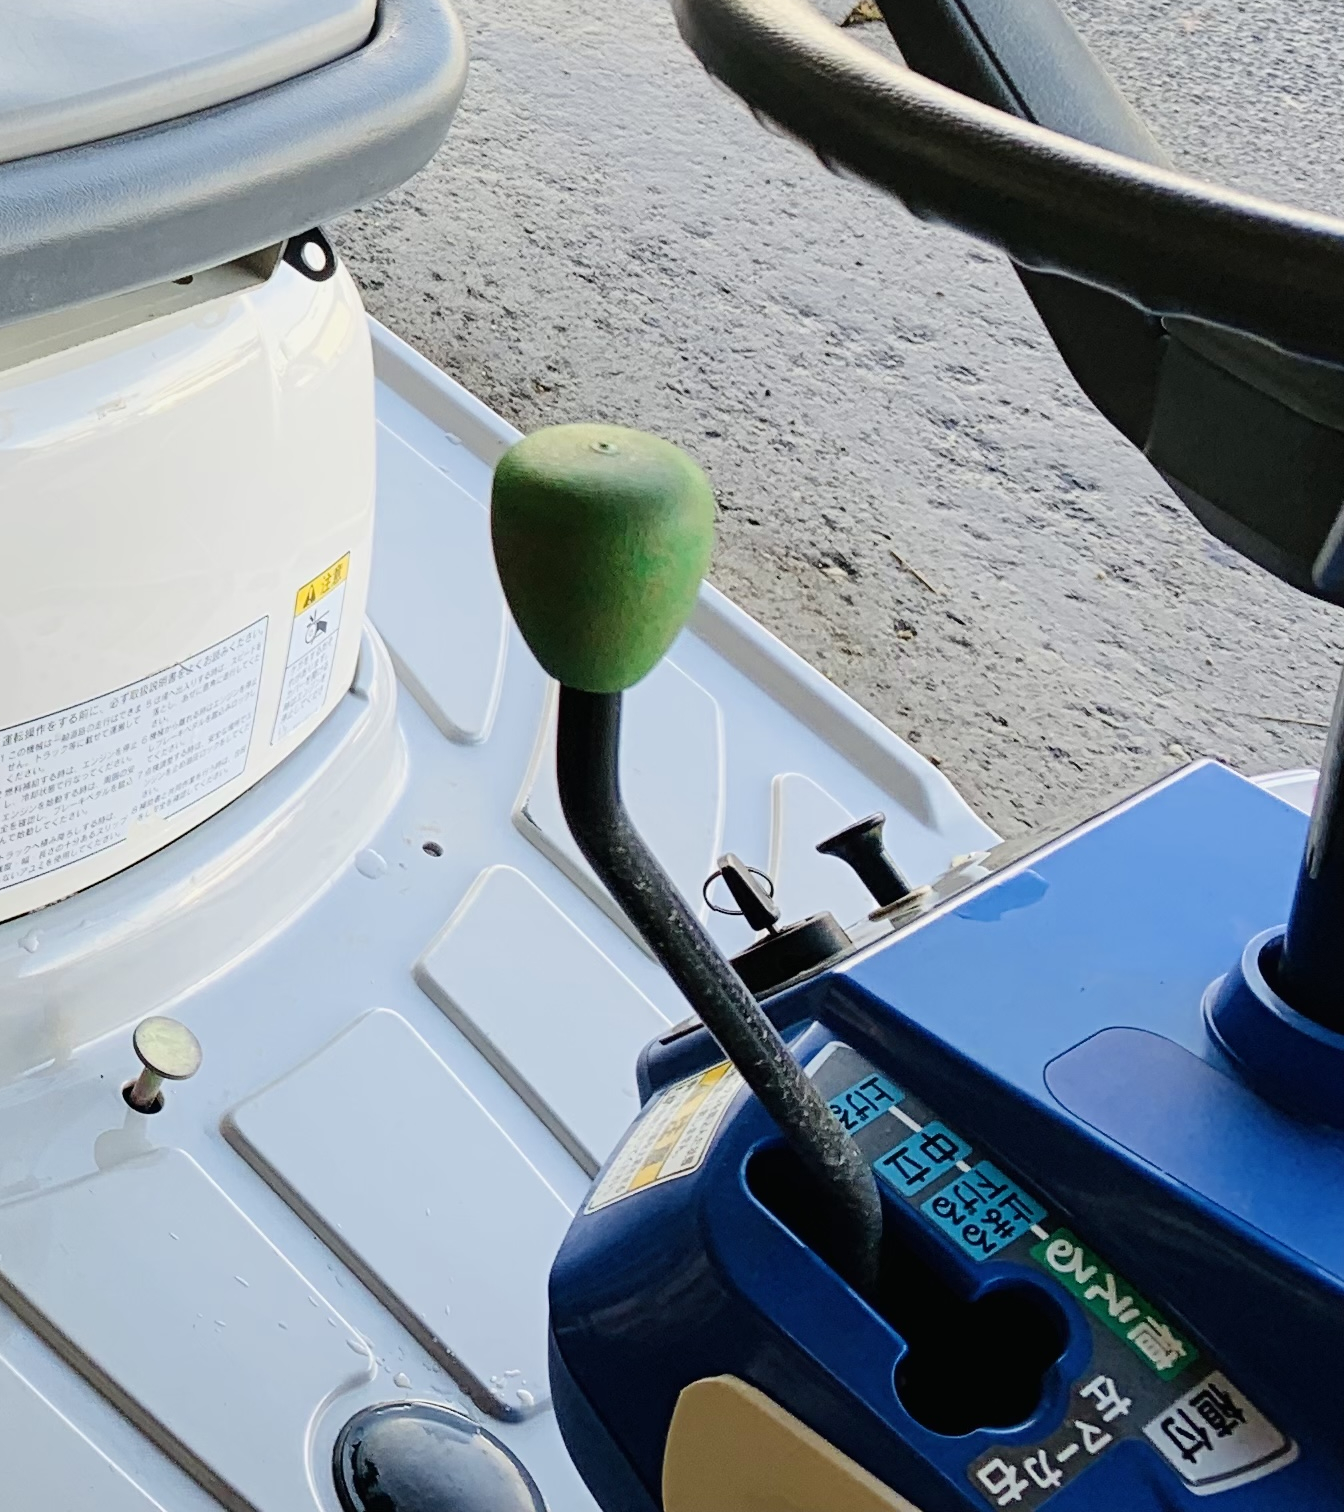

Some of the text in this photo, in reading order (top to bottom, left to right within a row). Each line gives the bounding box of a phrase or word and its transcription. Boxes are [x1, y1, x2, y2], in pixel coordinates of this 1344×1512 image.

[830, 1076, 895, 1130] 上げる
[883, 1132, 960, 1186] 中立
[933, 1170, 1008, 1225] 下げる
[962, 1192, 1032, 1253] 止まる
[1046, 1239, 1188, 1371] 植える
[1159, 1382, 1246, 1465] 植付
